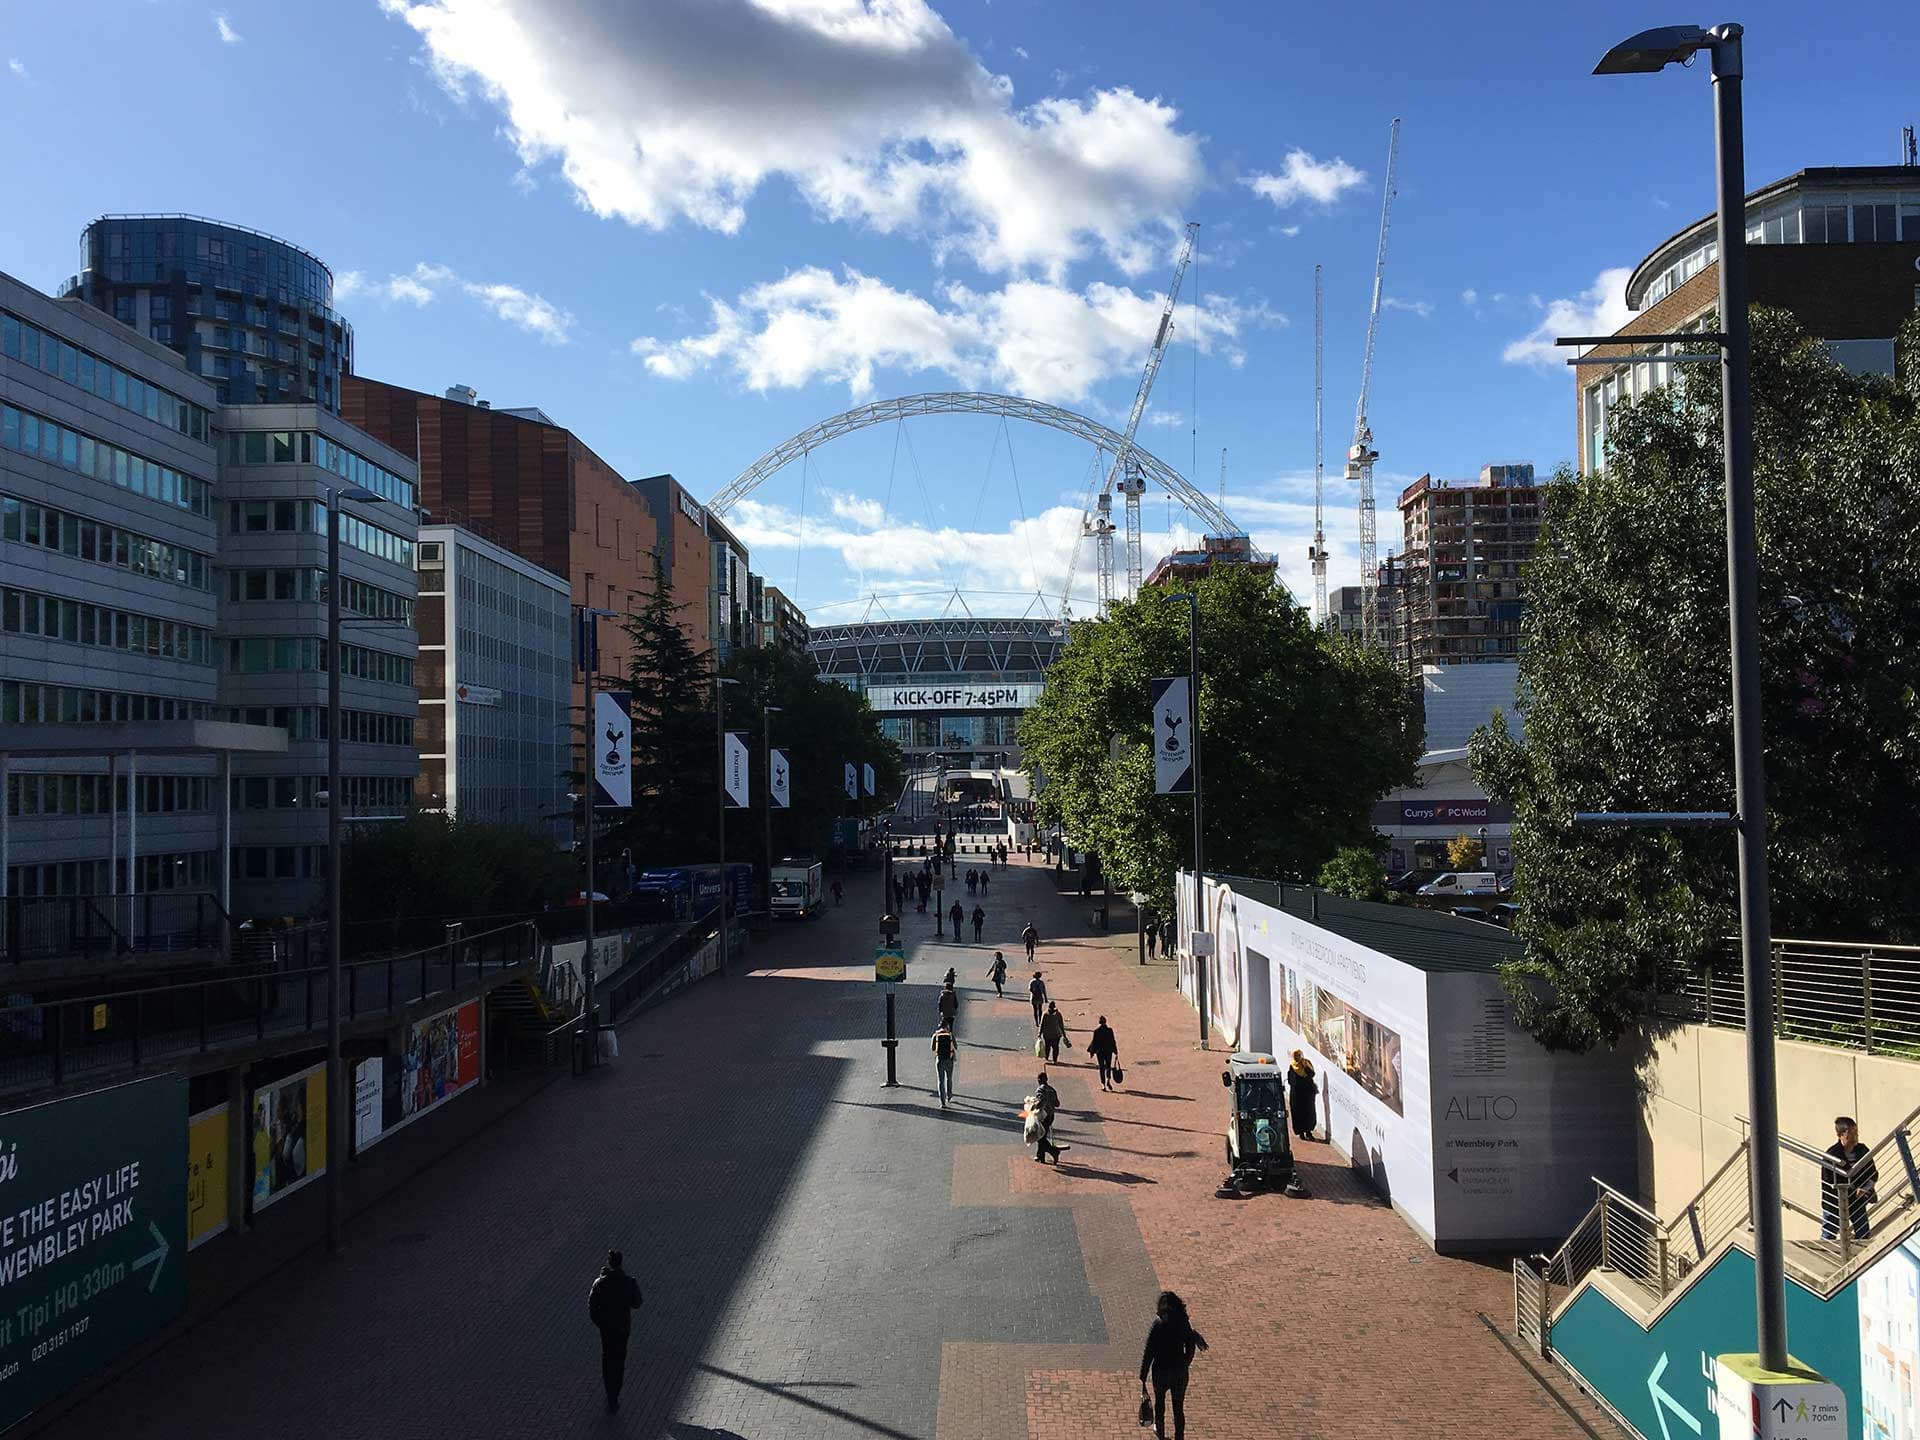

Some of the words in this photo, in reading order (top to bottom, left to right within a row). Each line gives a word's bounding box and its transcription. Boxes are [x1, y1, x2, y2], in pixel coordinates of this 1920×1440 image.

[893, 690, 961, 705] KICK-OFF
[965, 689, 1018, 706] 7:45PM
[1404, 808, 1434, 819] Currys
[1448, 808, 1461, 817] PC
[1461, 807, 1487, 817] World
[1444, 1095, 1518, 1121] ALTO
[1455, 1139, 1496, 1149] Wembley
[1497, 1140, 1519, 1148] Park
[19, 1198, 56, 1239] THE
[60, 1176, 102, 1221] EASY
[106, 1160, 140, 1200] LIFE
[0, 1217, 88, 1288] WEMBLEY
[92, 1196, 134, 1241] PARK
[17, 1295, 50, 1337] Tipi
[55, 1281, 79, 1318] HQ
[82, 1261, 125, 1301] 330m
[31, 1341, 48, 1362] 020
[48, 1328, 69, 1352] 3151
[70, 1315, 90, 1339] 1937
[1812, 1414, 1837, 1422] 700m
[1819, 1404, 1840, 1412] mins
